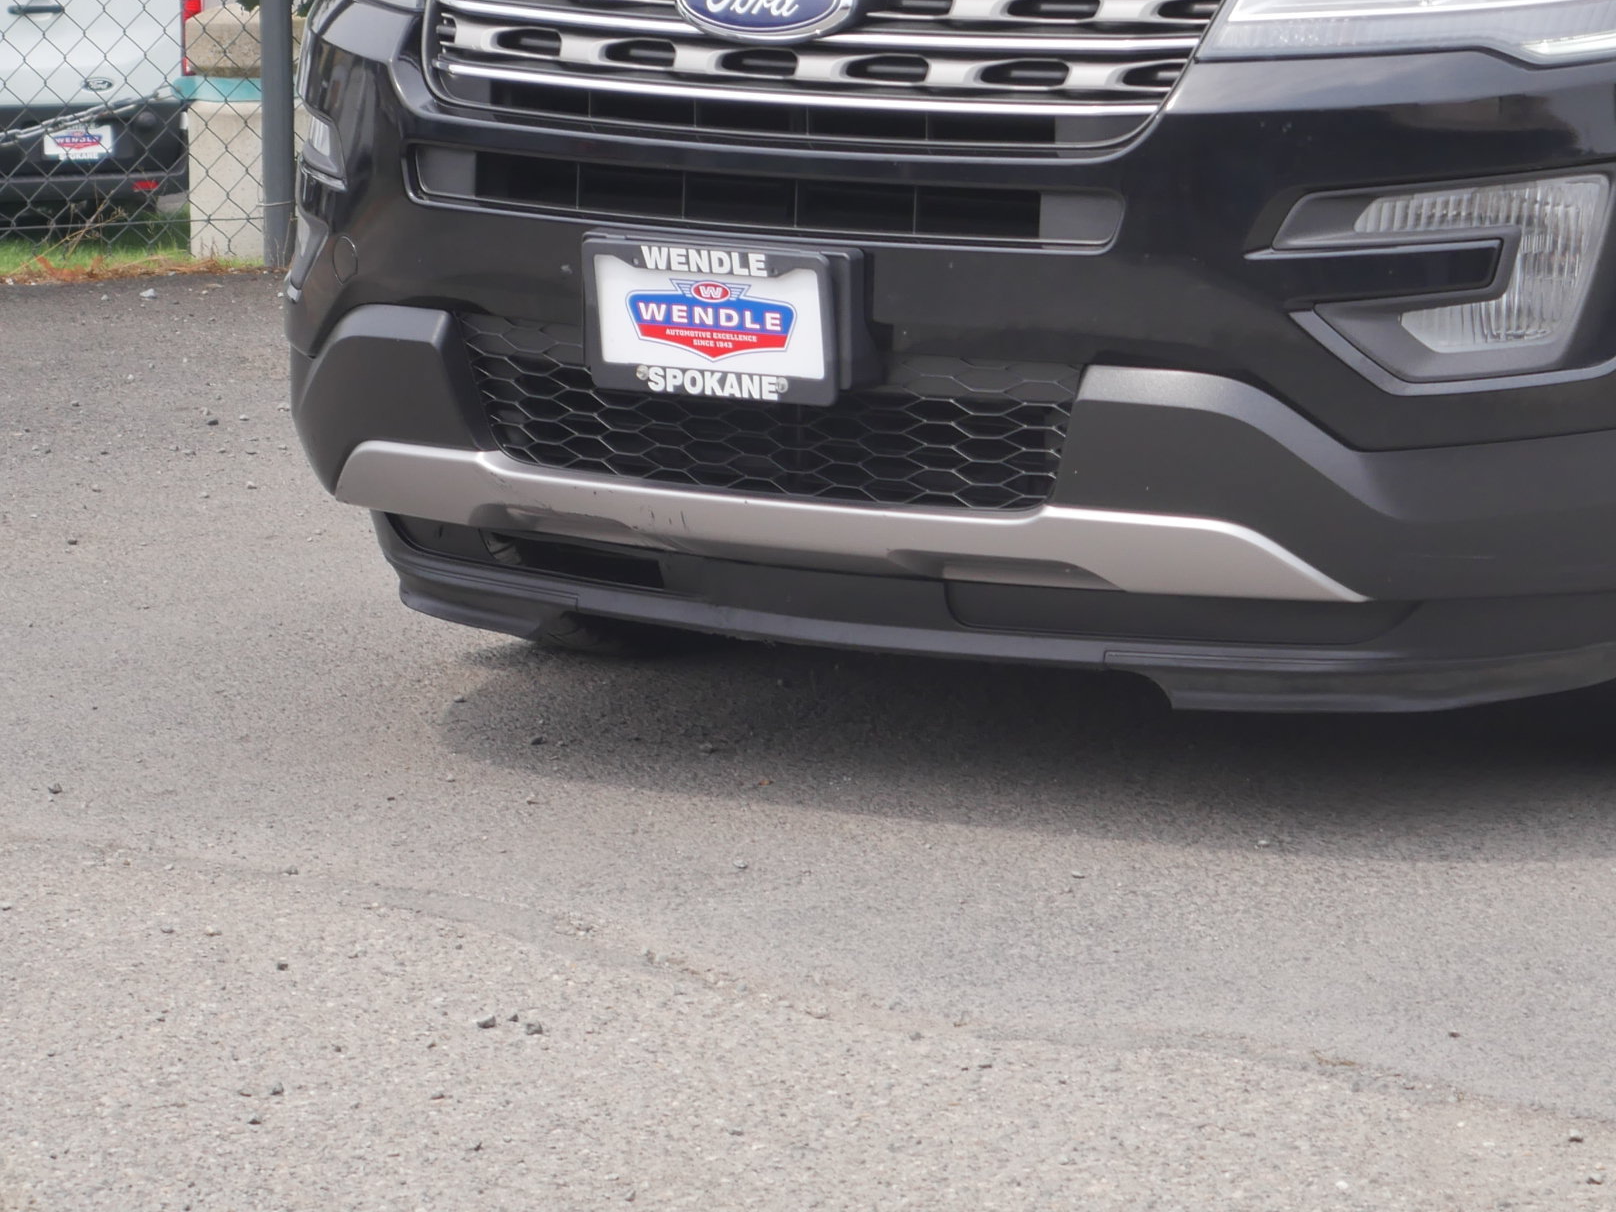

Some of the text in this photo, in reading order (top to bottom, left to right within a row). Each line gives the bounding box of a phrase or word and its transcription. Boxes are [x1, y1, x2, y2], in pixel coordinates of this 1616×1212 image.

[640, 245, 768, 277] WENDLE
[638, 302, 781, 330] WENDLE
[666, 328, 757, 342] AUTOMOTIVE EXCELLENCE
[693, 339, 733, 348] SINCE 1943
[648, 366, 779, 401] SPOKANE
